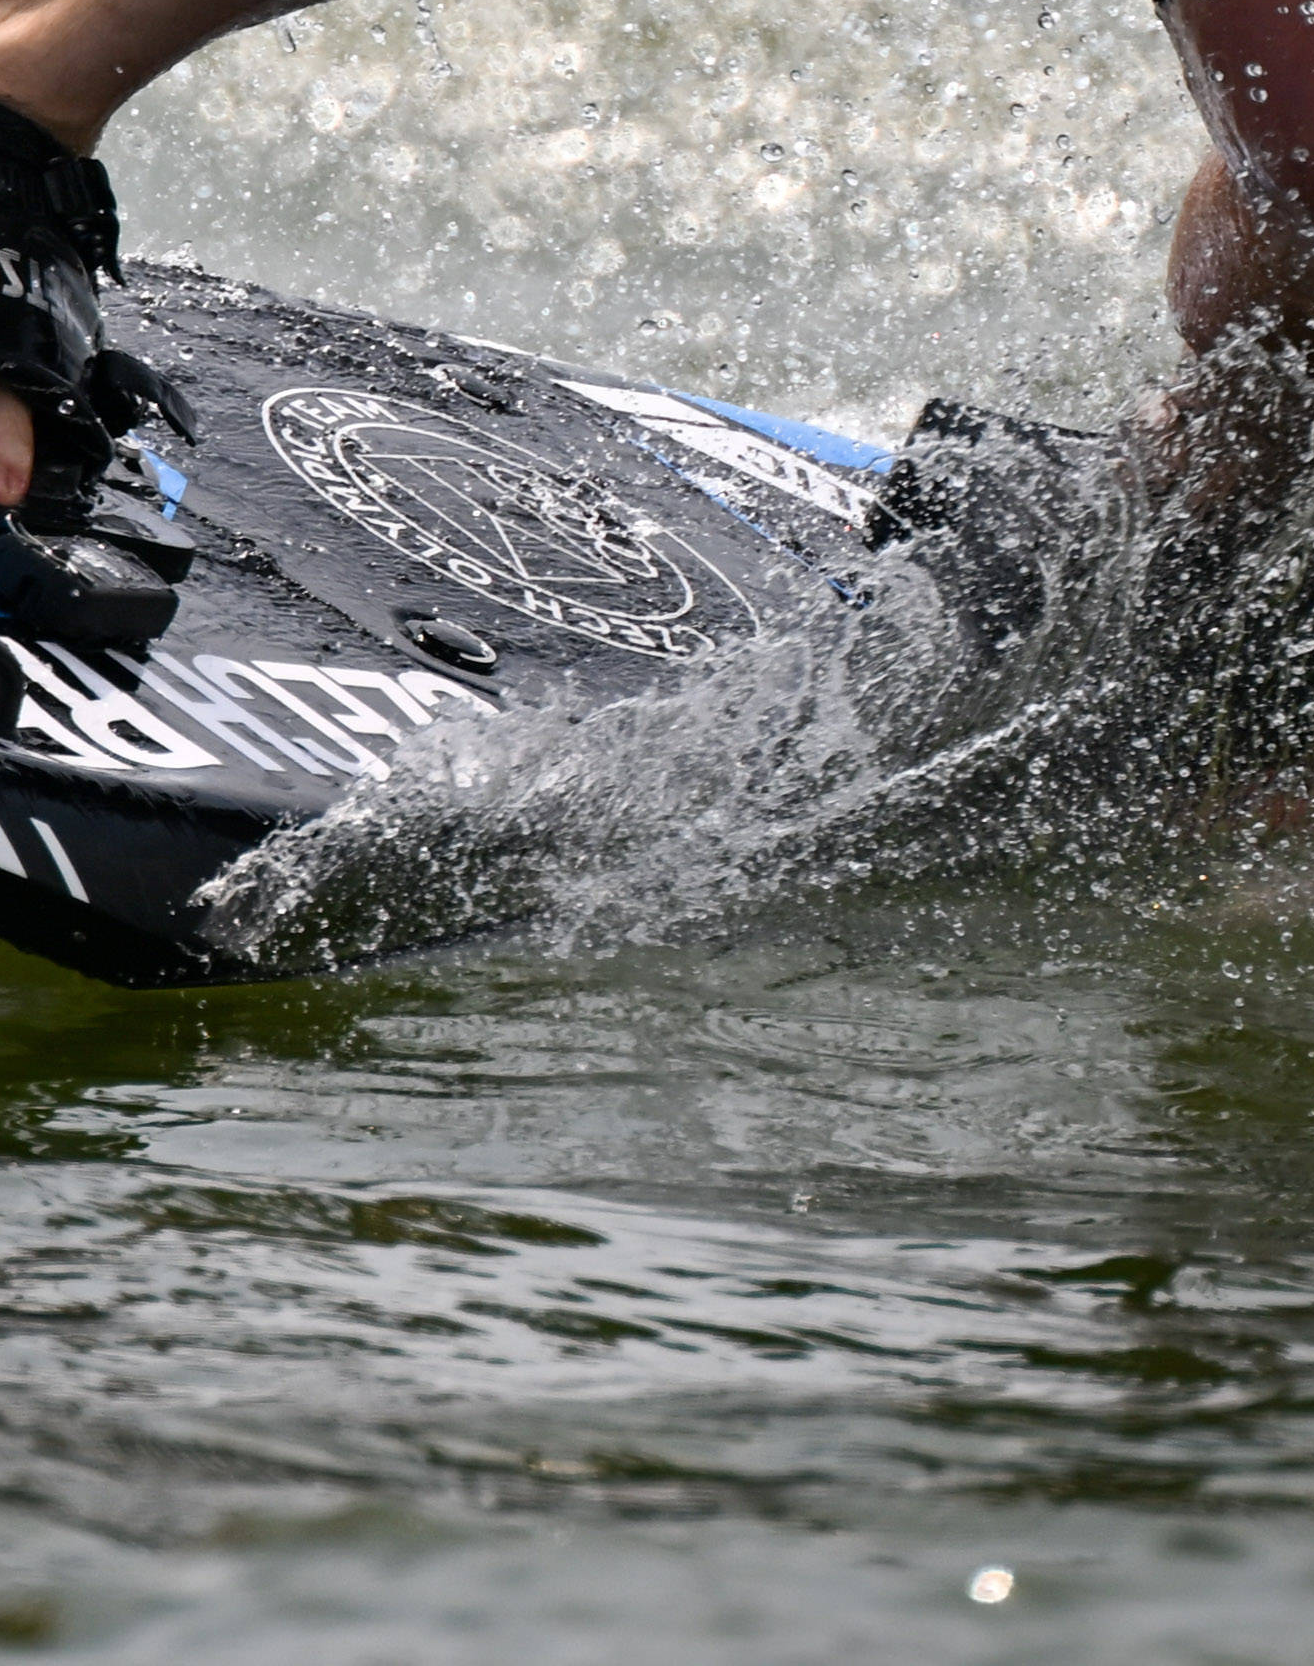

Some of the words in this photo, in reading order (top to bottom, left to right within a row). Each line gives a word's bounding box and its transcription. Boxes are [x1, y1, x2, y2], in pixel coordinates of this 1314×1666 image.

[281, 395, 399, 432] TEAM
[282, 424, 492, 586] OLYMPIC
[523, 588, 716, 659] CZECH
